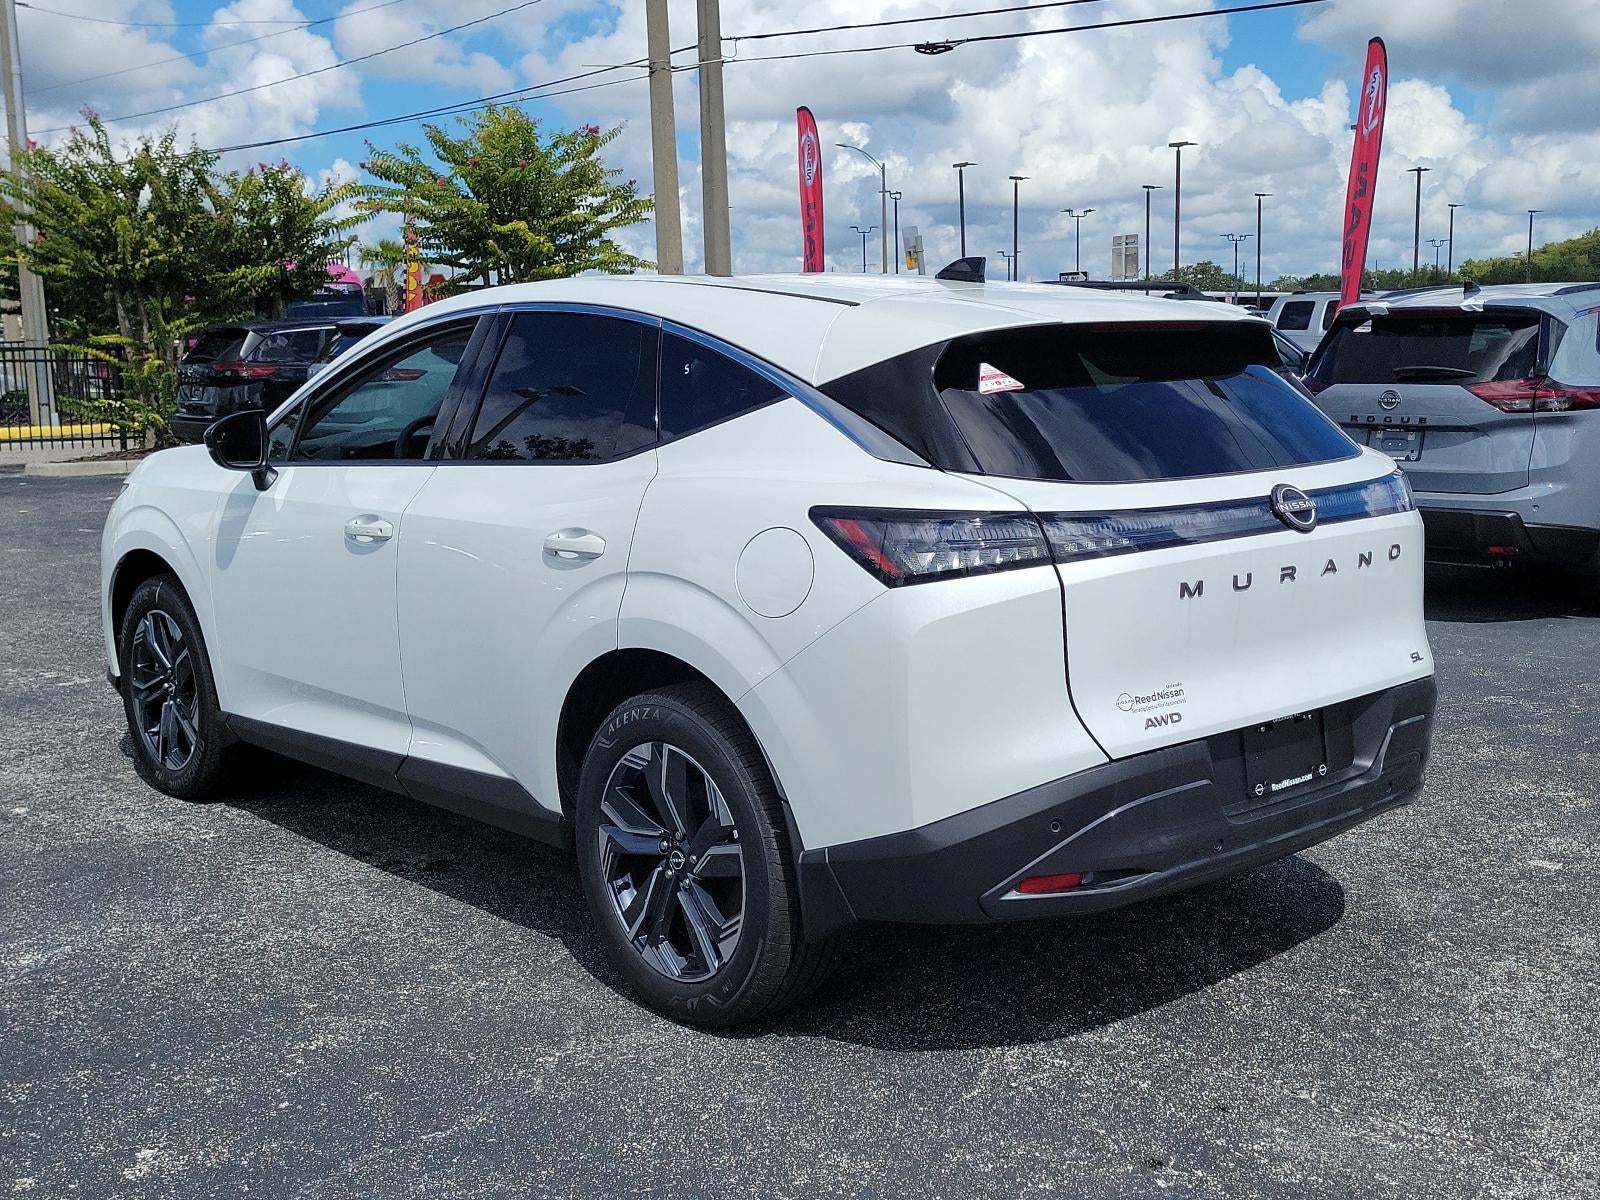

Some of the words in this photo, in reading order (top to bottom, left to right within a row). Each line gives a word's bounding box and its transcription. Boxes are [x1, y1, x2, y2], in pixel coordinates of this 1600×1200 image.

[1350, 414, 1428, 424] ROGUE
[1279, 498, 1317, 512] NISSAN
[1179, 543, 1402, 600] MURANO
[1410, 651, 1424, 663] SL
[608, 707, 660, 736] ALENZA
[1144, 712, 1182, 730] AWD
